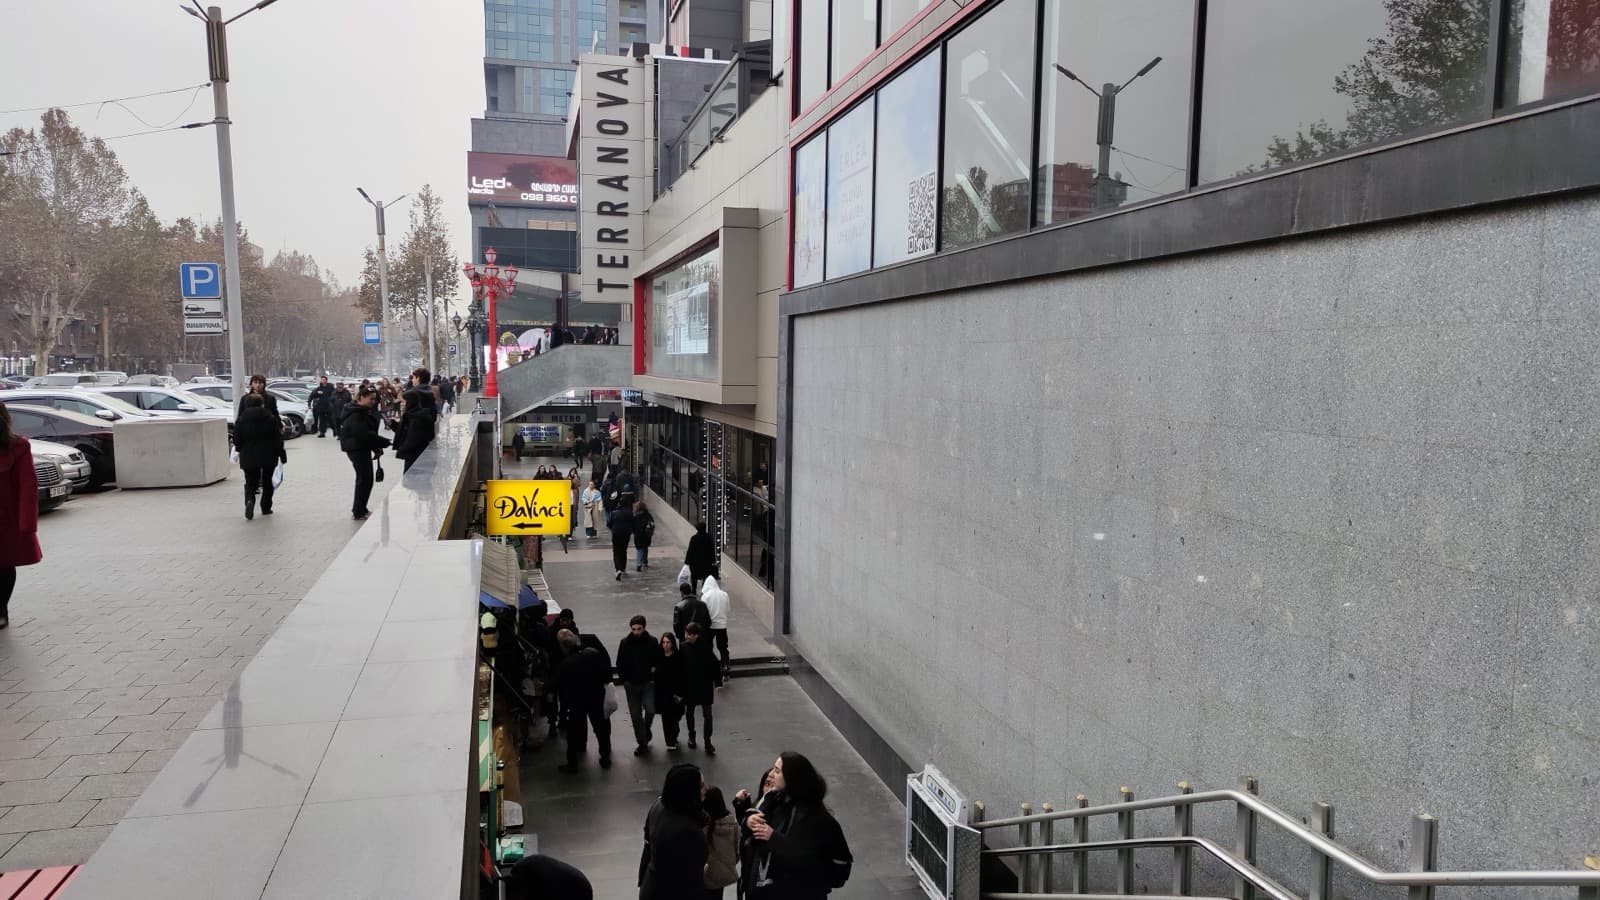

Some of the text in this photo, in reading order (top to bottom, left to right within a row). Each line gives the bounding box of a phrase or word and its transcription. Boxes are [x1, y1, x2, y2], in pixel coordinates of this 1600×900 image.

[472, 176, 506, 189] Led
[597, 68, 629, 293] TERRANOVA
[189, 266, 214, 295] P
[552, 415, 581, 423] METRO
[494, 488, 564, 520] DaVinci
